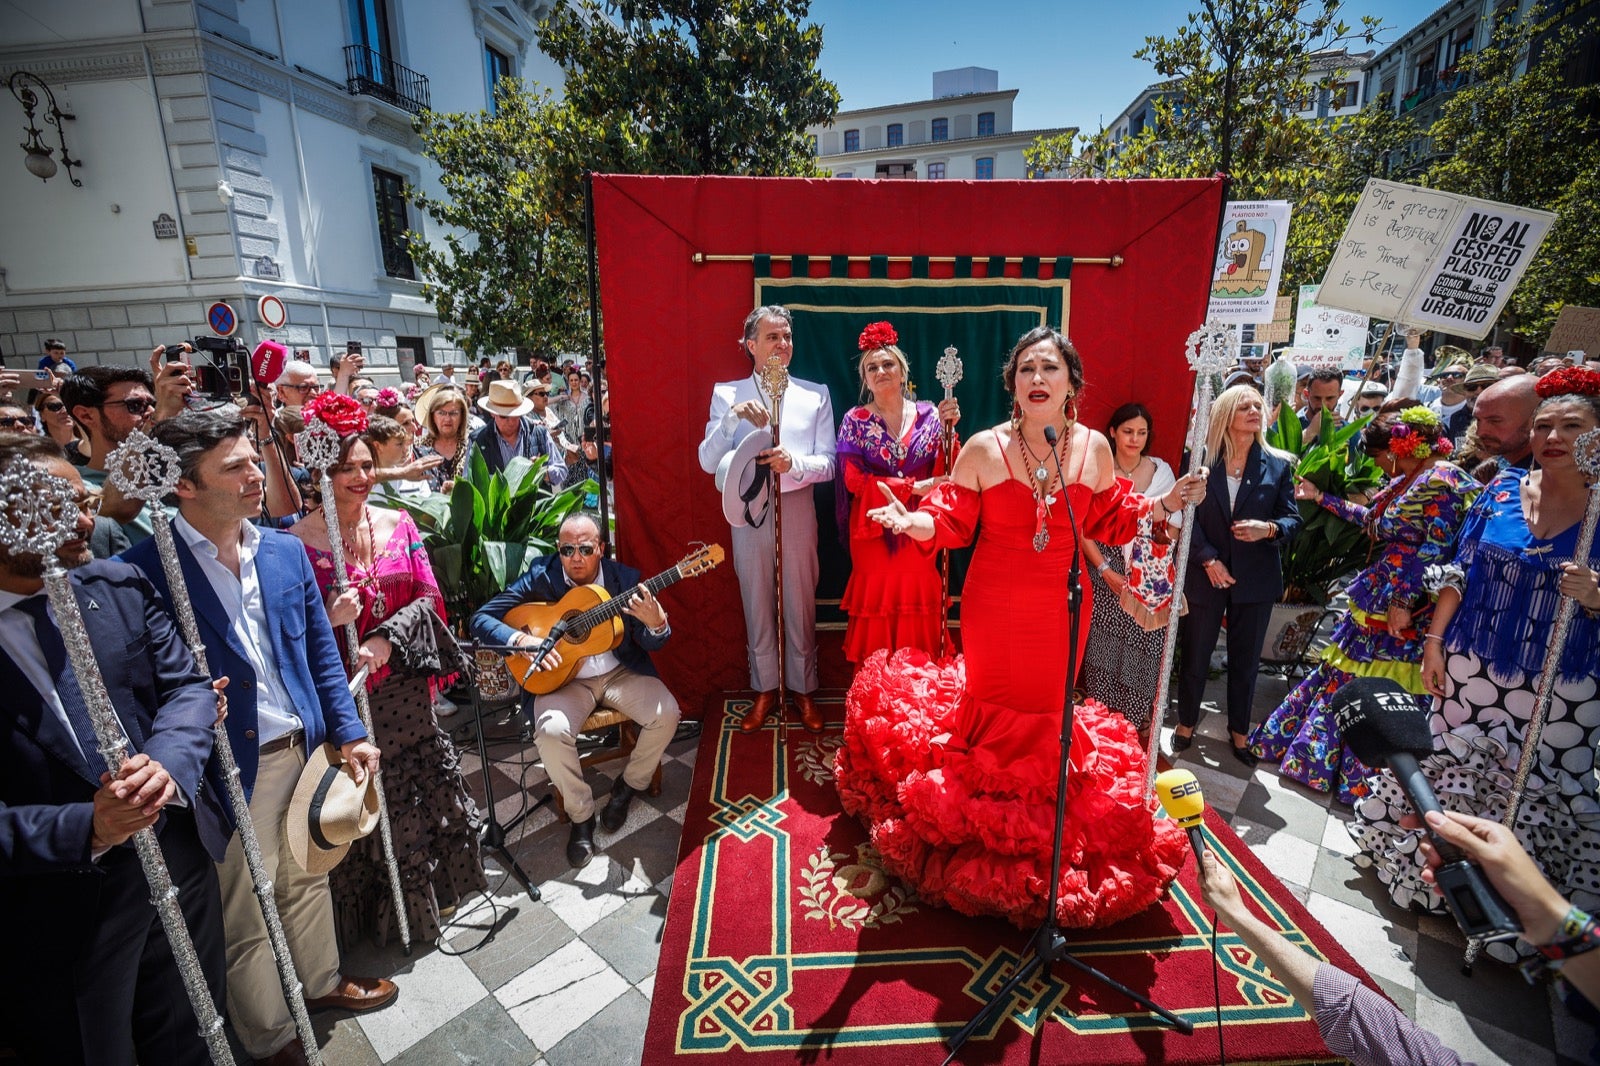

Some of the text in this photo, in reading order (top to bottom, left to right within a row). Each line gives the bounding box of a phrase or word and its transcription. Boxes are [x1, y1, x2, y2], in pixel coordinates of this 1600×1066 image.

[1372, 188, 1448, 220] The green
[1363, 213, 1379, 227] is
[1462, 212, 1531, 249] NO AL
[1345, 240, 1410, 269] The Threat
[1452, 237, 1522, 267] CÉSPED
[1340, 270, 1356, 286] is
[1443, 256, 1511, 283] PLÁSTICO
[1431, 285, 1494, 305] RECUBRIMIENTO
[1436, 276, 1464, 291] COMO
[1421, 297, 1488, 324] URBANO
[1292, 354, 1324, 362] CALOR
